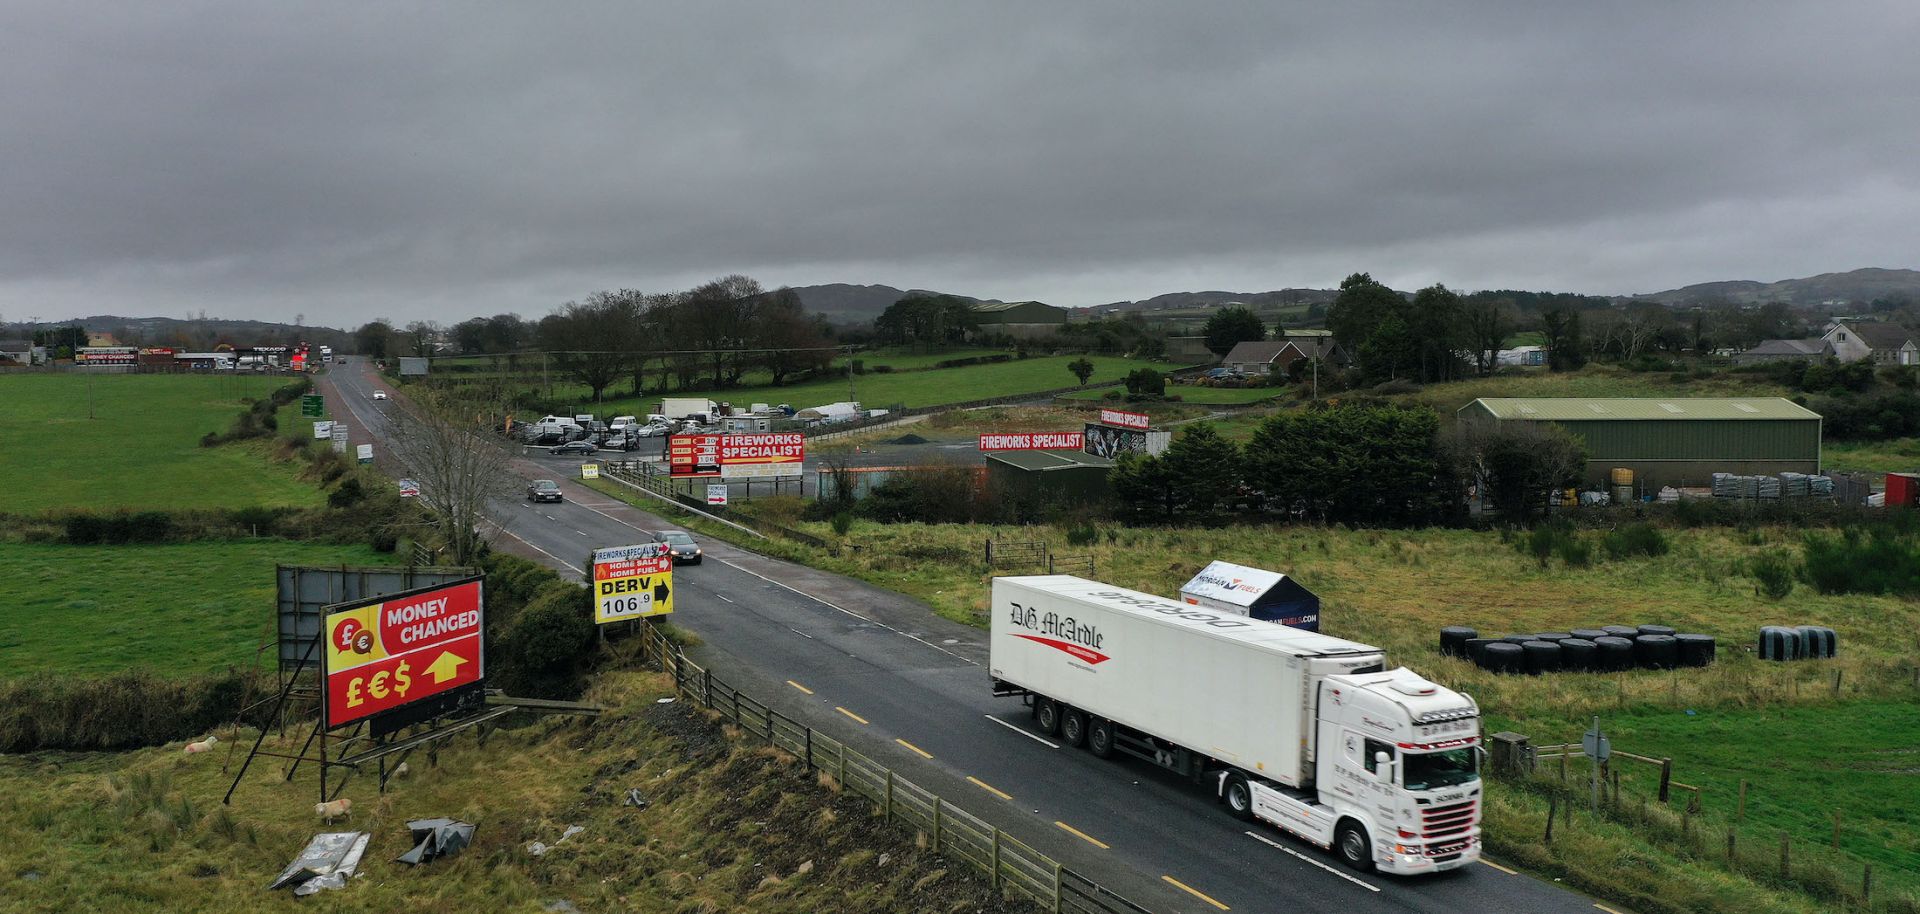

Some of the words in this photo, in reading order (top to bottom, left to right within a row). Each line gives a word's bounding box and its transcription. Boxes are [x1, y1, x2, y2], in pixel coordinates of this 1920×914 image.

[1101, 410, 1124, 424] FIREWORKS
[1124, 413, 1149, 429] SPECIALIST
[722, 435, 802, 446] FIREWORKS
[981, 435, 1030, 449] FIREWORKS
[1032, 433, 1081, 448] SPECIALIST
[722, 446, 802, 457] SPECIALIST
[610, 560, 635, 569] HOME
[637, 558, 658, 566] SALE
[610, 568, 635, 577] HOME
[637, 566, 658, 574] FUEL
[602, 577, 651, 595] DERV
[1196, 575, 1227, 588] MORGAN
[1237, 584, 1261, 594] FUELS
[388, 597, 448, 627] MONEY
[400, 610, 479, 644] CHANGED
[1041, 612, 1104, 650] McArdle
